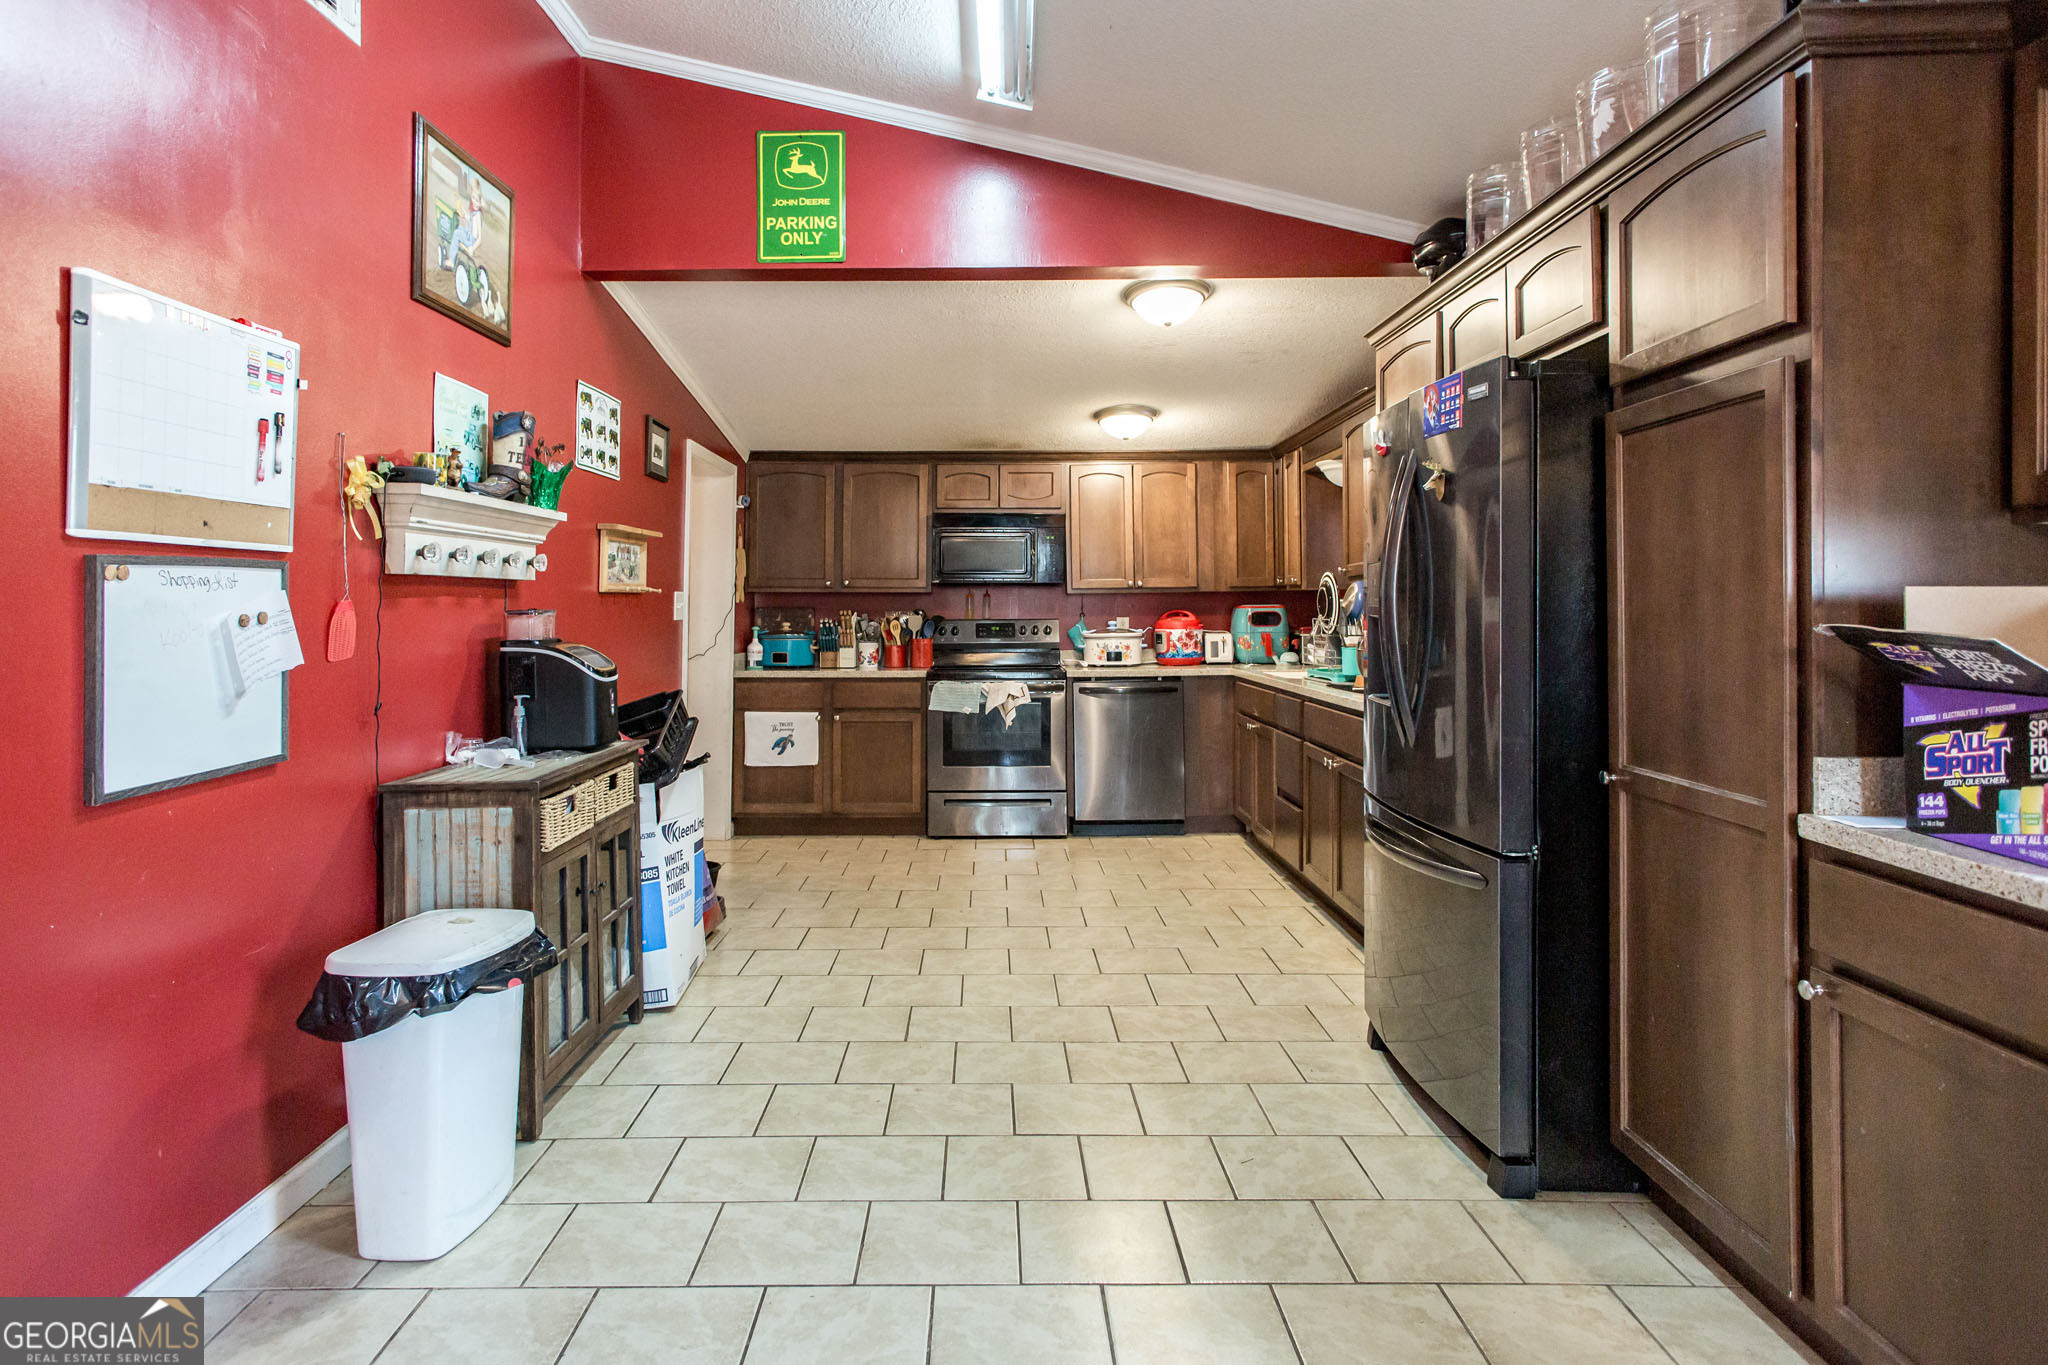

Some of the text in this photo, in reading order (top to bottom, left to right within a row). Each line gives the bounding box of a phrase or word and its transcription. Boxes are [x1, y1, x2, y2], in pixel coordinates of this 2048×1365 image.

[772, 197, 831, 207] JOHN DEERE
[766, 215, 837, 230] PARKING
[780, 231, 823, 245] ONLY
[507, 451, 524, 463] TE
[158, 569, 239, 592] Shopping List
[1932, 647, 2002, 663] SPORTS
[1947, 658, 2027, 676] FREEZER
[1962, 669, 2014, 684] POPS
[1942, 708, 1979, 719] ELECTROLYTES
[1985, 703, 2016, 714] POTASSIUM
[2028, 719, 2048, 737] SP
[1947, 730, 1987, 754] ALL
[2029, 737, 2048, 756] FR
[1924, 738, 2011, 780] SPORT
[2030, 755, 2048, 773] PO
[1944, 776, 2007, 787] BODY QUENCHER
[1919, 795, 1945, 808] 144
[640, 832, 656, 840] 5305
[671, 818, 704, 842] KleenLine
[1990, 835, 2003, 845] GET
[2004, 835, 2012, 845] IN
[2014, 835, 2027, 845] THE
[2028, 835, 2041, 845] ALL
[664, 849, 683, 867] WHITE
[665, 861, 690, 882] KITCHEN
[666, 878, 686, 896] TOWEL
